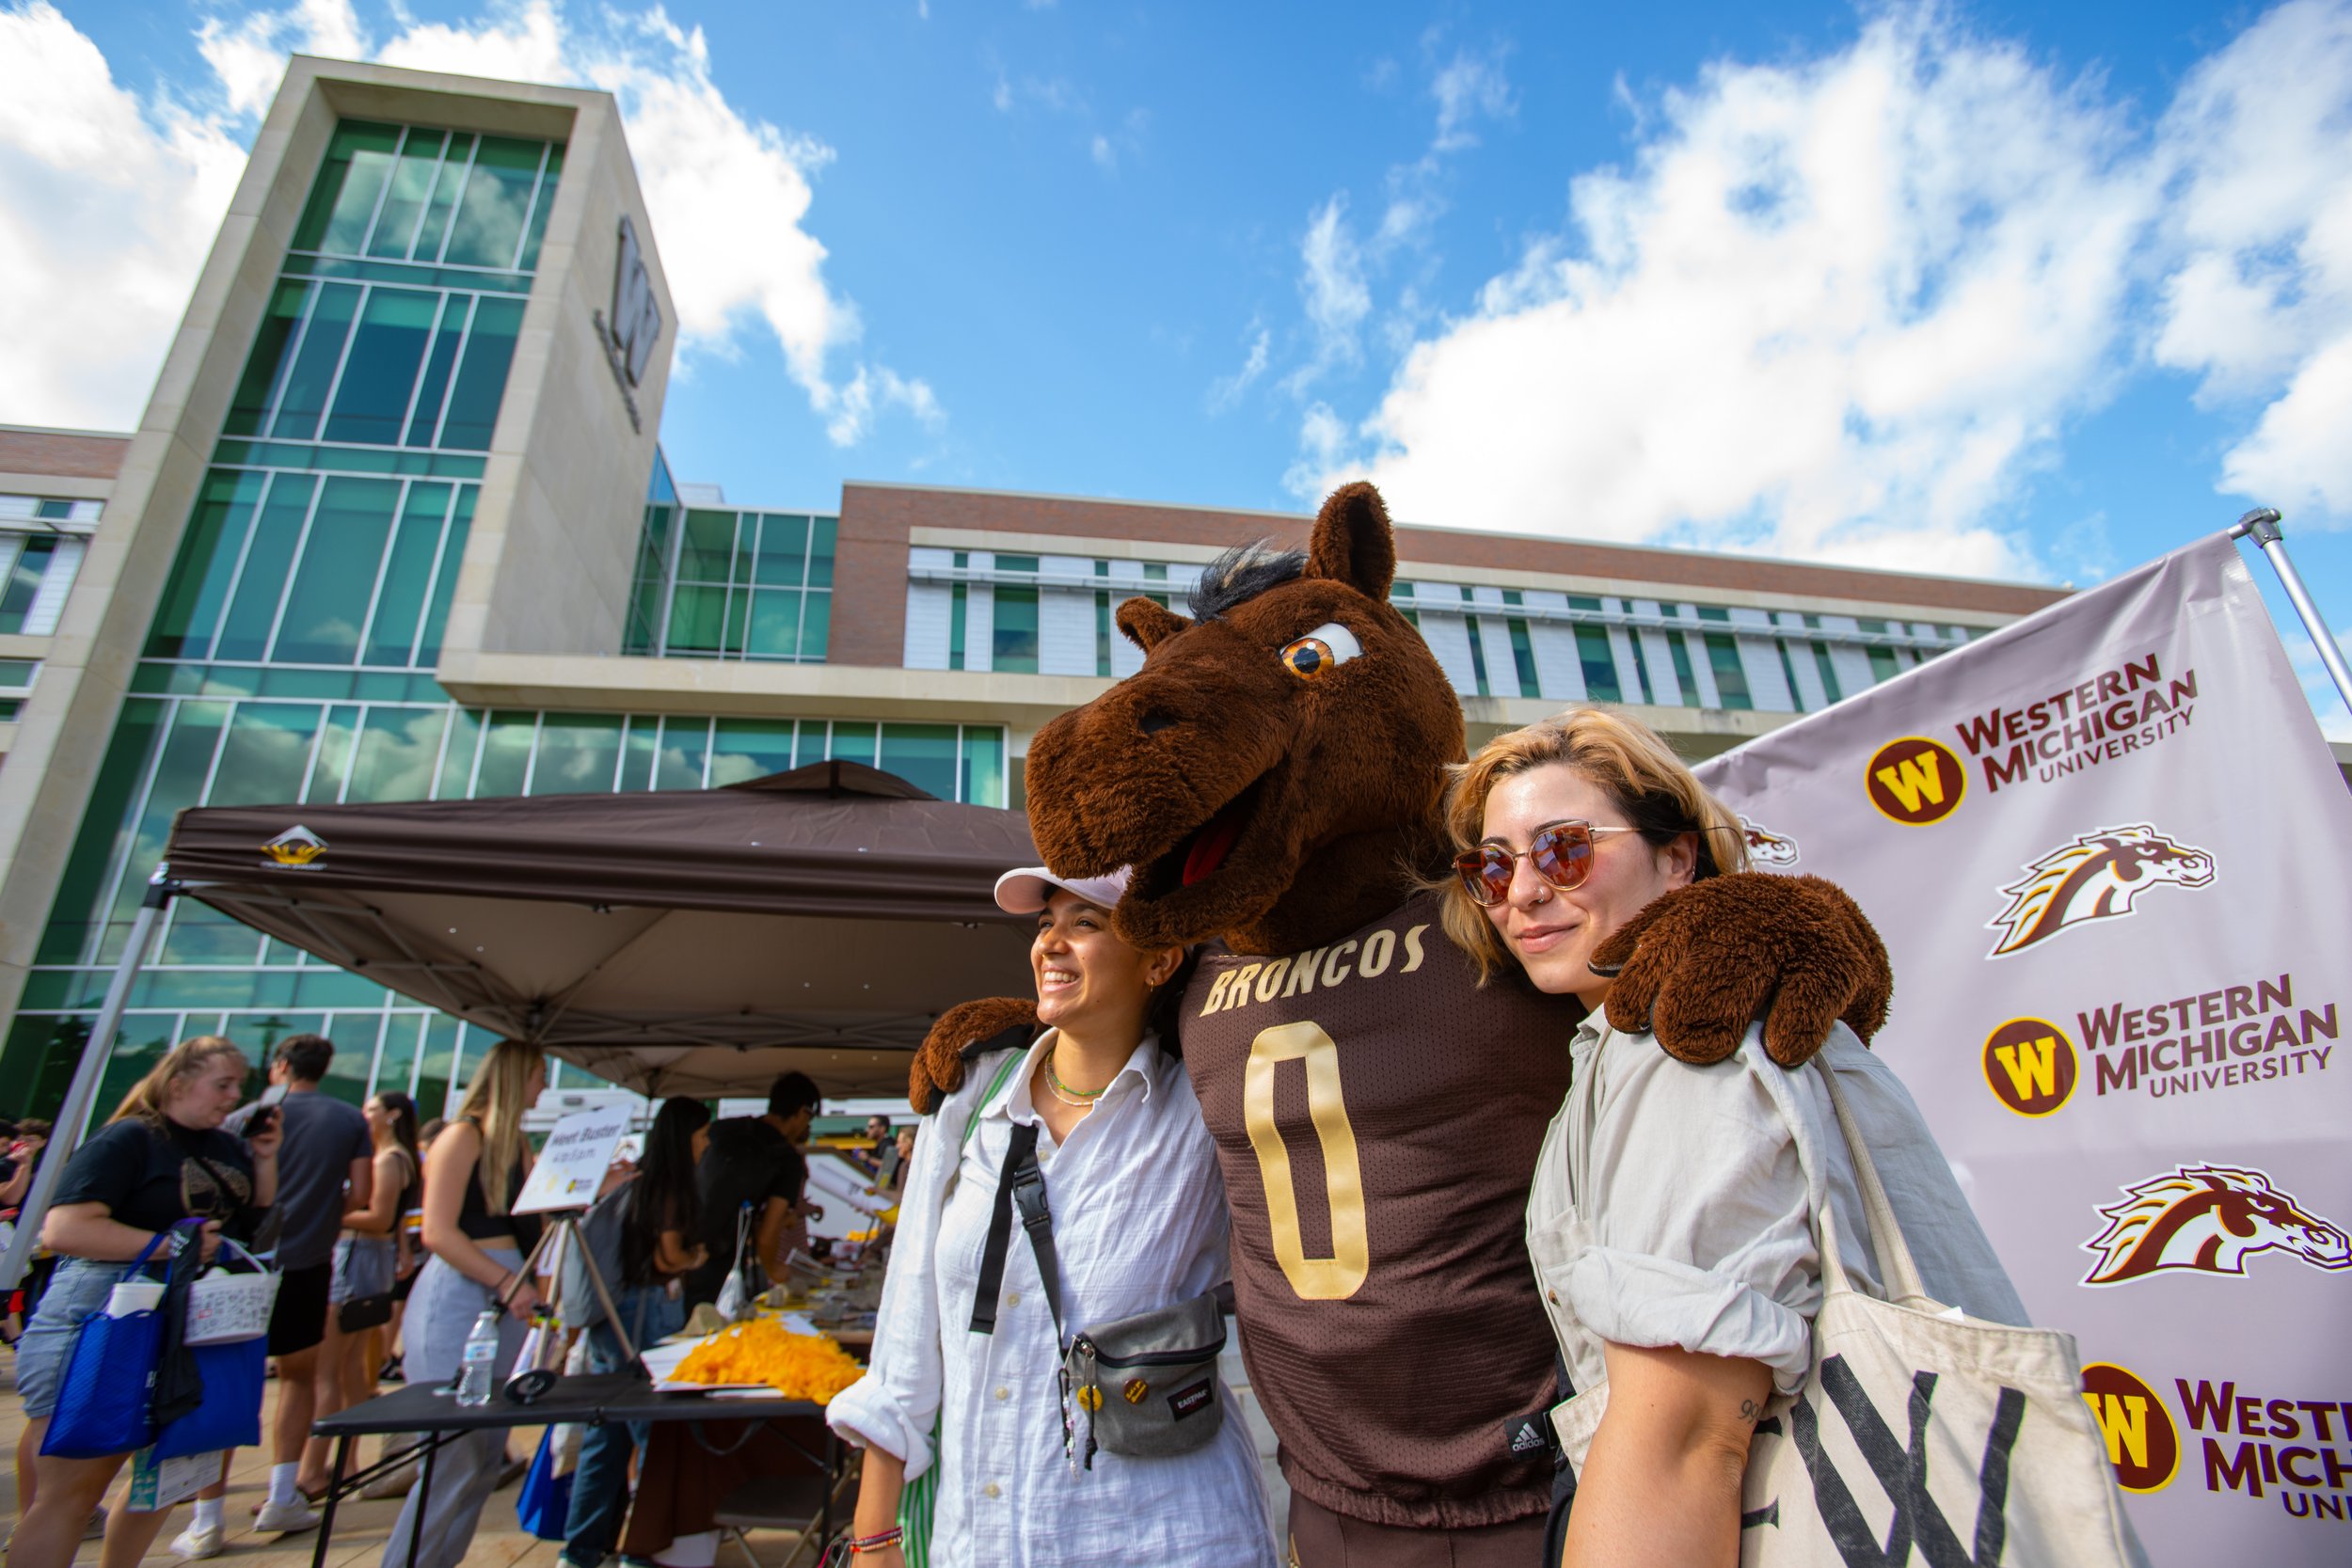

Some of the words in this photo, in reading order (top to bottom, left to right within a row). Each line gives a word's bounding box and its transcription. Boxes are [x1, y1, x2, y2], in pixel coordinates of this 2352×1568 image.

[1955, 653, 2162, 756] WESTERN
[1981, 669, 2198, 793] MICHIGAN
[1875, 750, 1946, 813] W
[2039, 705, 2194, 784] UNIVERSITY
[1200, 924, 1431, 1018] BRONCOS
[2076, 973, 2294, 1051] WESTERN
[2095, 1003, 2339, 1096] MICHIGAN
[1994, 1036, 2058, 1101] W
[2149, 1045, 2333, 1099] UNIVERSITY
[1244, 1021, 1370, 1300] 0
[1177, 1390, 1207, 1409] EASTPAK
[1512, 1438, 1545, 1451] adidas
